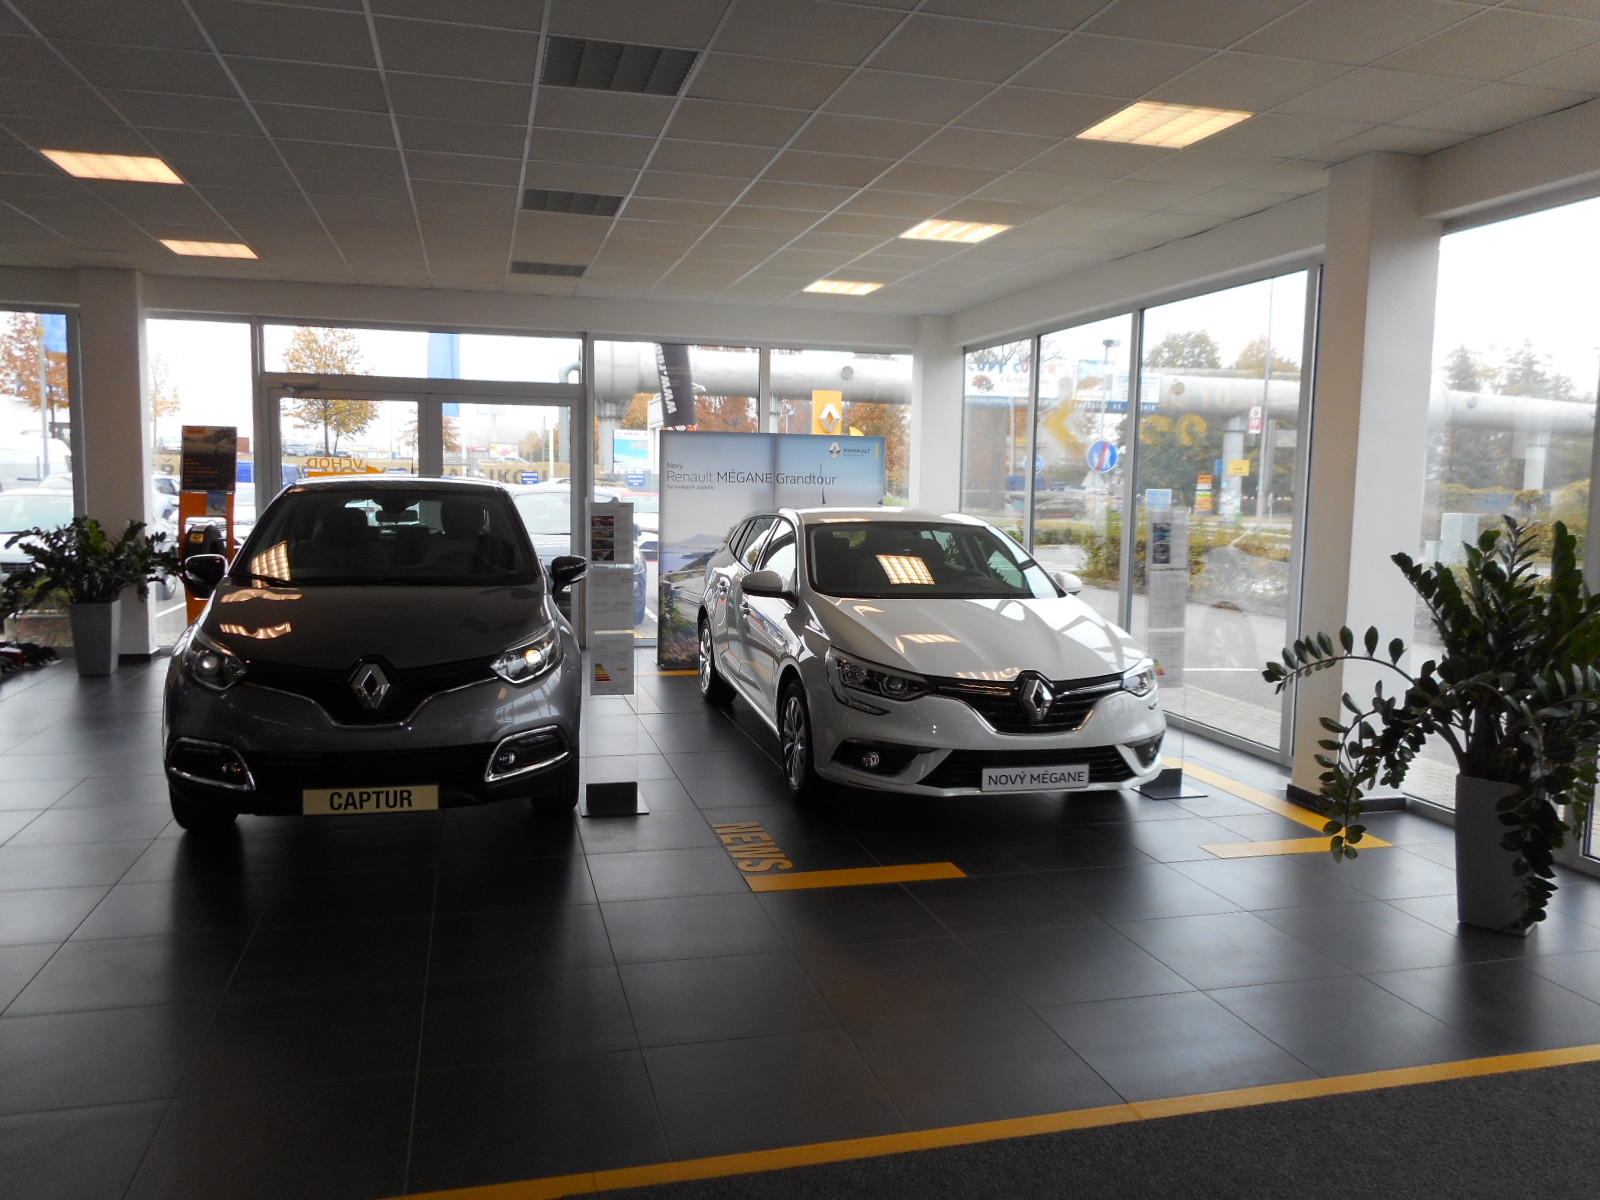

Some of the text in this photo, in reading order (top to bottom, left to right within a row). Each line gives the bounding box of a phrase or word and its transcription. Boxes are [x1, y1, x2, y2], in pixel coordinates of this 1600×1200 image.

[666, 462, 684, 470] Nový
[666, 470, 837, 485] Renault MÉGANE Grandtour
[988, 769, 1085, 786] NOVÝ MÉGANE
[329, 789, 412, 811] CAPTUR
[712, 821, 793, 873] NEWS
